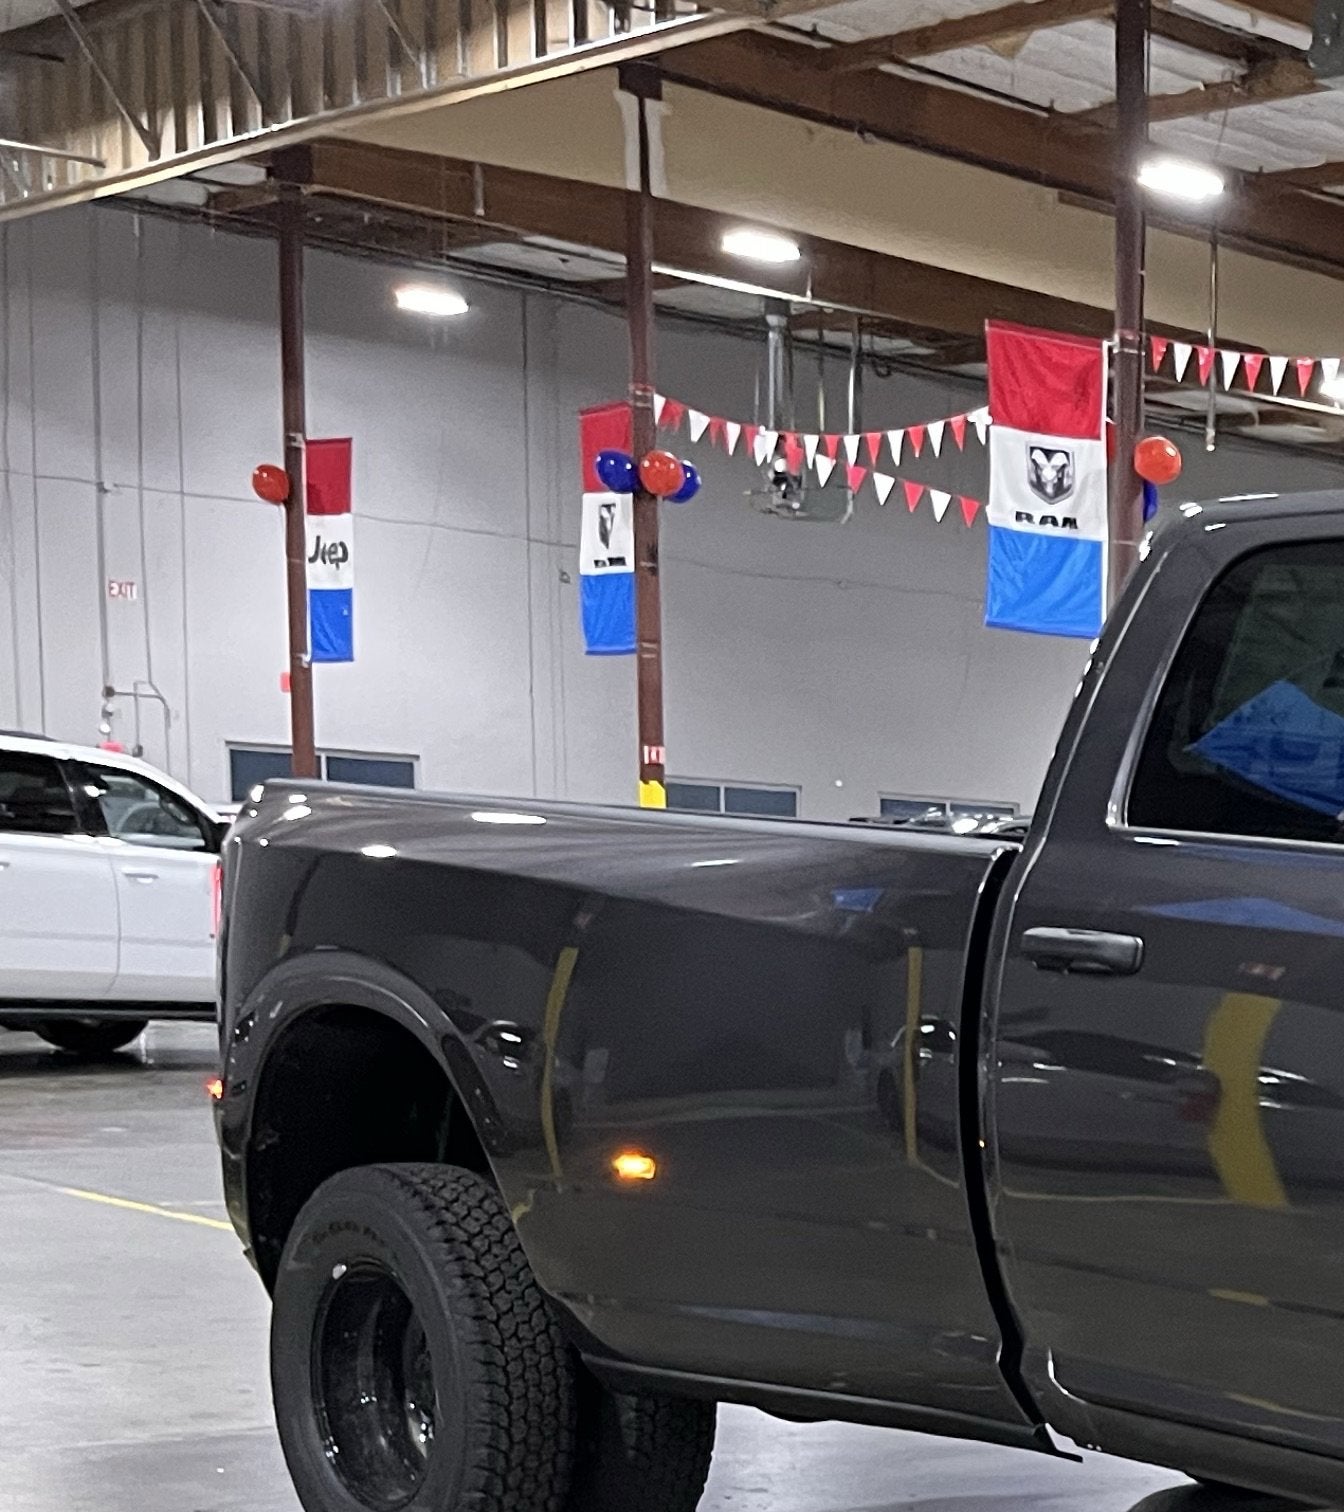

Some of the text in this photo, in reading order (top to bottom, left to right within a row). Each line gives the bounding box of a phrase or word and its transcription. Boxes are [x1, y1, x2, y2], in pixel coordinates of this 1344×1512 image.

[1015, 510, 1079, 530] RAM
[308, 535, 349, 570] Jeep
[108, 580, 137, 599] EXIT
